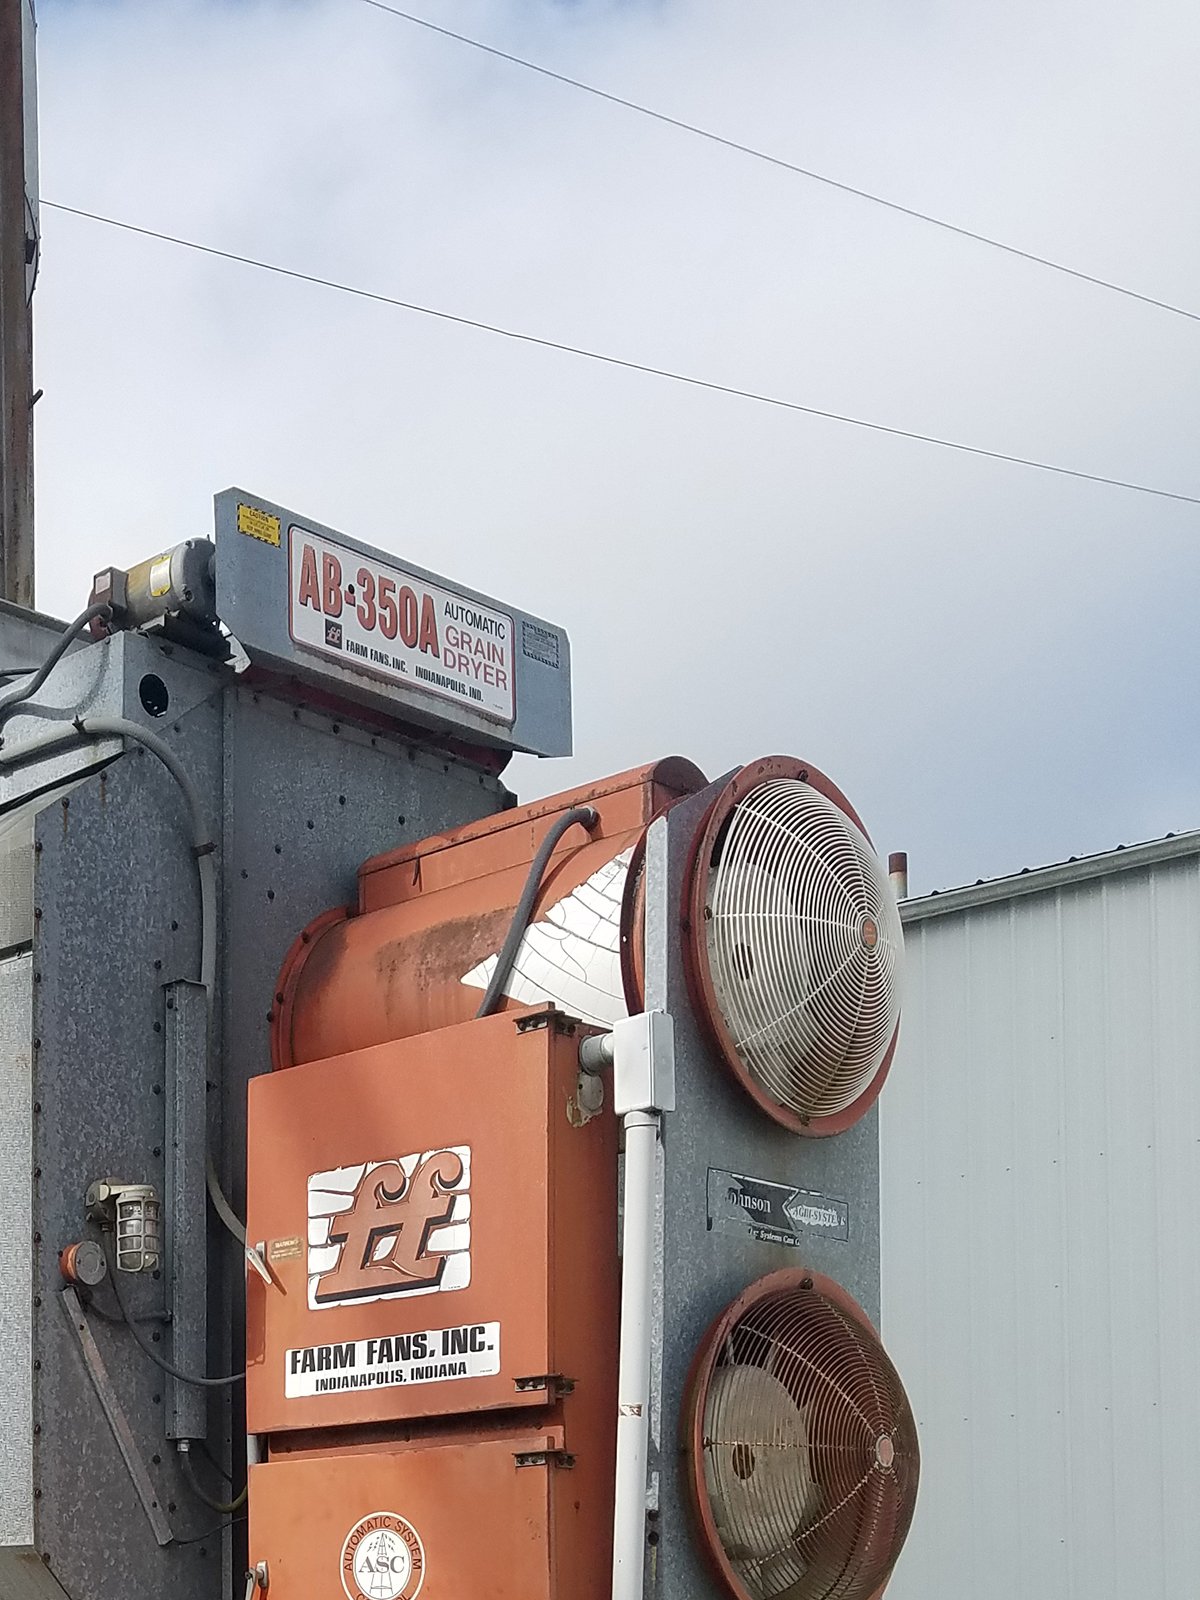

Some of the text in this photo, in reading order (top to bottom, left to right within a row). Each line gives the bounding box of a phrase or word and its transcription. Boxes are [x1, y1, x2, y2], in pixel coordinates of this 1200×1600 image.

[299, 543, 440, 659] AB-350A
[444, 601, 506, 640] AUTOMATIC
[445, 625, 505, 666] GRAIN
[346, 639, 368, 659] FARM
[392, 656, 408, 673] INC.
[469, 686, 484, 702] IND.
[443, 647, 508, 691] DRYER
[728, 1189, 772, 1214] ohnson
[291, 1325, 494, 1374] FARM FANS, INC.
[315, 1361, 467, 1392] INDIANAPOLIS, INDIANA
[344, 1516, 422, 1571] AUTOMATIC SYSTEM
[358, 1555, 405, 1574] ASC
